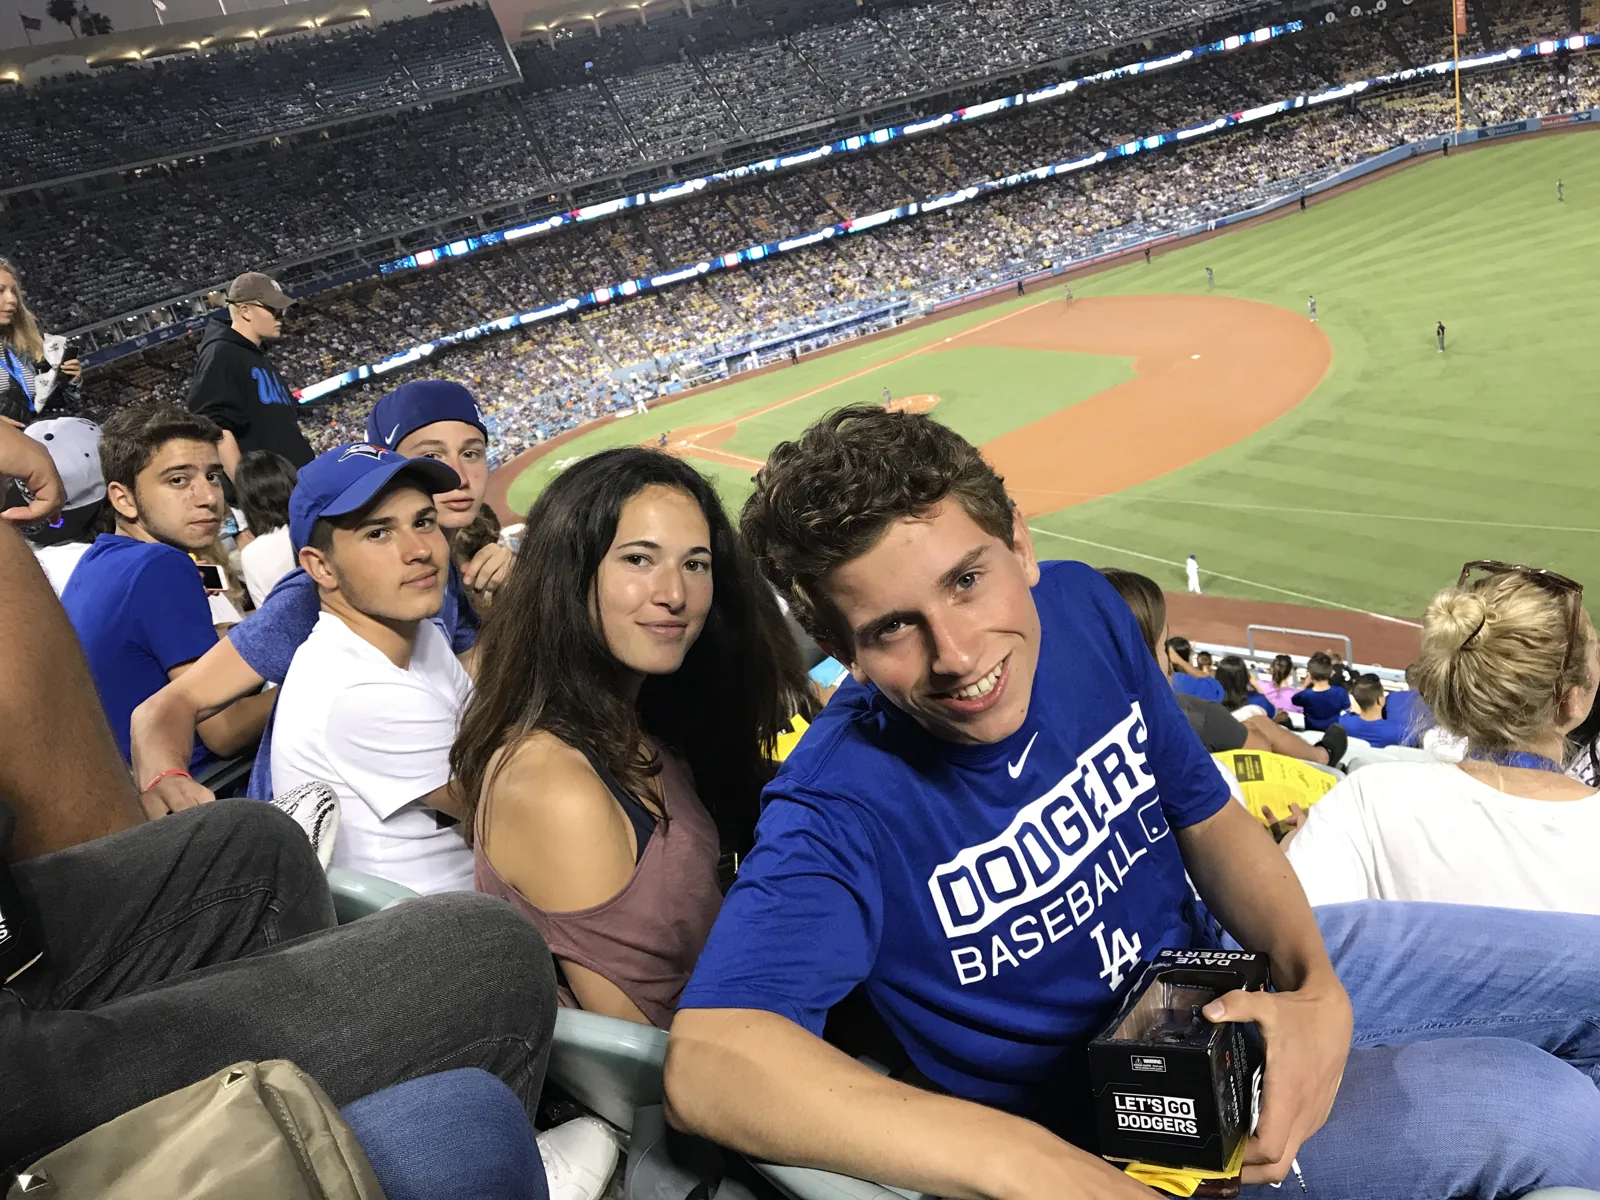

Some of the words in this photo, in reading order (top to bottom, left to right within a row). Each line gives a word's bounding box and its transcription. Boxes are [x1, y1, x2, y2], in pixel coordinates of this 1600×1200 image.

[931, 716, 1154, 932] DODGERS
[951, 831, 1148, 986] BASEBALL
[1090, 921, 1143, 992] LA
[1160, 950, 1257, 961] ROBERTS
[1175, 957, 1231, 967] DAVE
[1114, 1095, 1163, 1113] LET'S
[1167, 1100, 1192, 1115] GO
[1117, 1113, 1198, 1134] DODGERS
